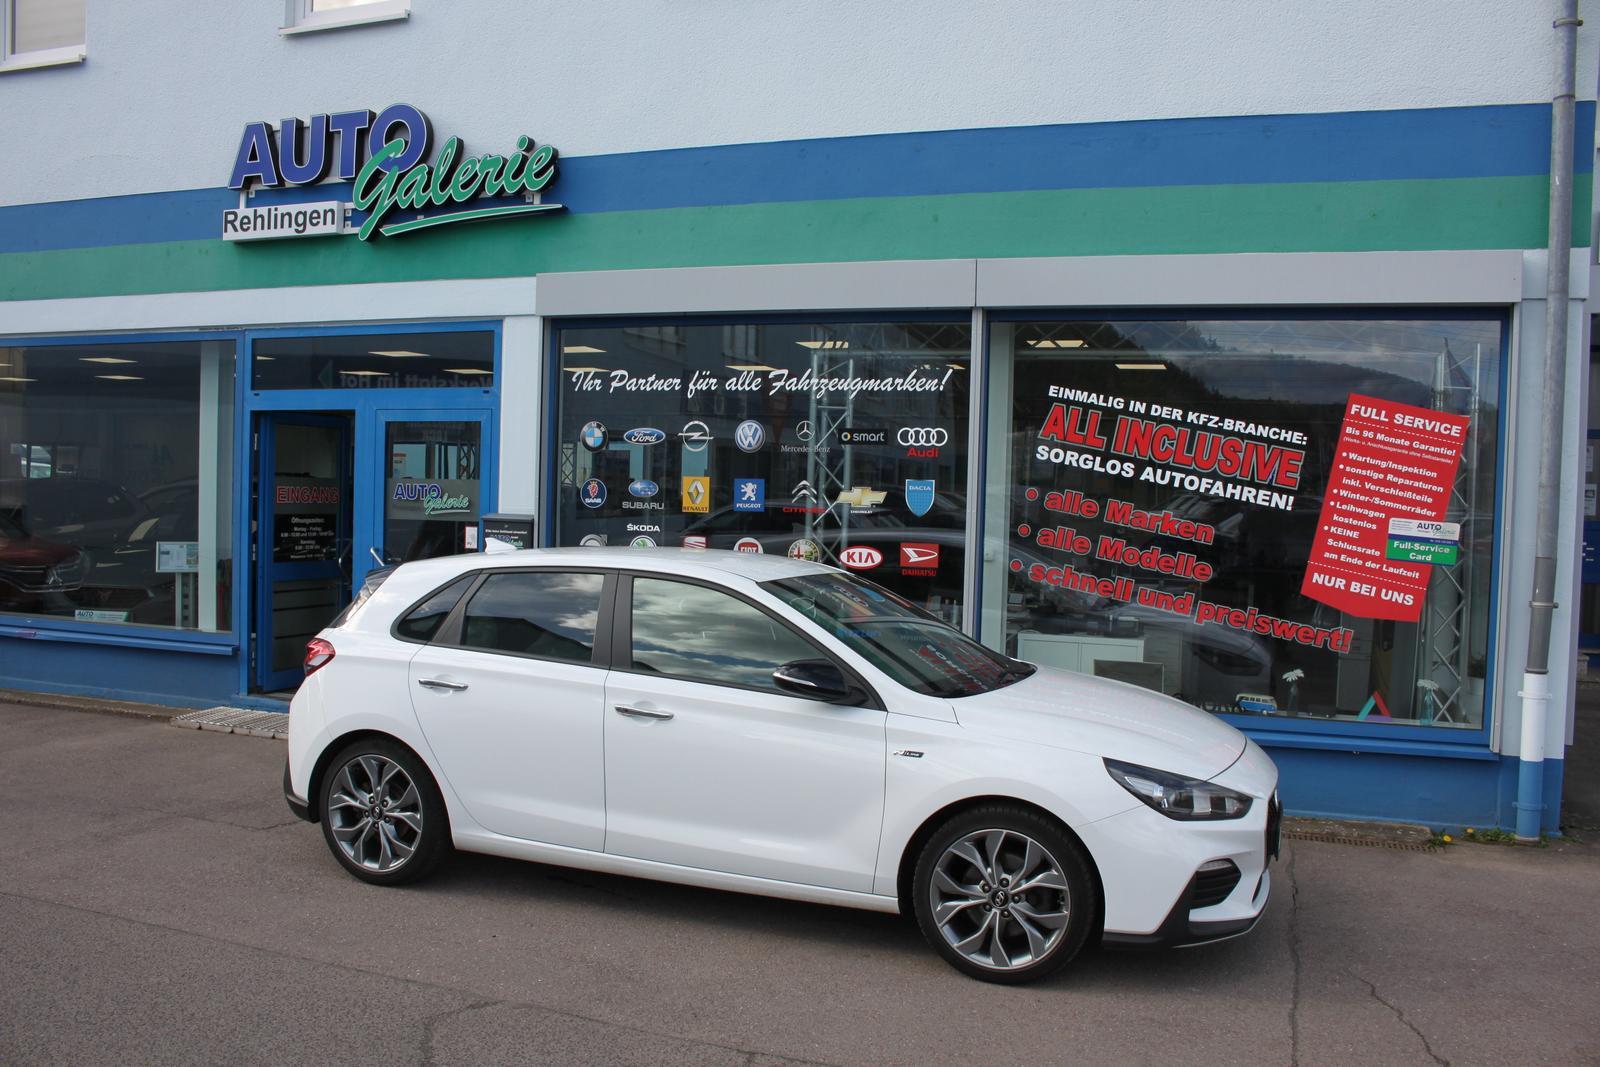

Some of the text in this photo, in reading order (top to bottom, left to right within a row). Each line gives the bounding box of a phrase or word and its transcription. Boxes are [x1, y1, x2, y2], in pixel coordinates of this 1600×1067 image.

[227, 103, 429, 190] AUTO
[353, 135, 555, 241] Galerie
[223, 205, 336, 233] Rehlingen
[572, 368, 954, 399] Ihr Partner für alle Fahrzeugmarken!
[1048, 385, 1308, 445] EINMALIG IN DER KFZ-BRANCHE:
[1350, 404, 1462, 437] FULL SERVICE
[630, 430, 658, 443] Ford
[852, 431, 885, 442] smart
[1038, 402, 1306, 490] ALL INCLUSIVE
[1345, 426, 1456, 456] Bis 96 Monate Garantie!
[907, 447, 939, 458] Audi
[1348, 452, 1438, 478] Wartung/Inspektion
[1035, 445, 1295, 511] SORGLOS AUTOFAHREN!
[1342, 477, 1433, 504] inkl. Verschleißteile
[1345, 465, 1444, 493] sonstige Reparaturen
[276, 486, 340, 503] EINGANG
[394, 483, 442, 500] AUTO
[423, 490, 470, 515] Galerie
[1339, 489, 1437, 517] Winter-/Sommerräder
[622, 501, 665, 510] SUBARU
[1044, 488, 1216, 545] alle Marken
[1336, 501, 1386, 519] Leihwagen
[626, 523, 661, 532] ŠKODA
[1330, 525, 1360, 538] KEINE
[1333, 514, 1377, 530] kostenlos
[1417, 522, 1442, 531] AUTO
[846, 551, 875, 563] KIA
[1037, 524, 1213, 582] alle Modelle
[1327, 538, 1381, 557] Schlussrate
[1393, 541, 1450, 554] Full-Service
[1409, 552, 1432, 561] Card
[902, 569, 937, 577] DAIHATSU
[1323, 551, 1420, 579] am Ende der Laufzeit
[1312, 572, 1414, 606] NUR BEI UNS
[1028, 563, 1354, 655] schnell und preiswert!
